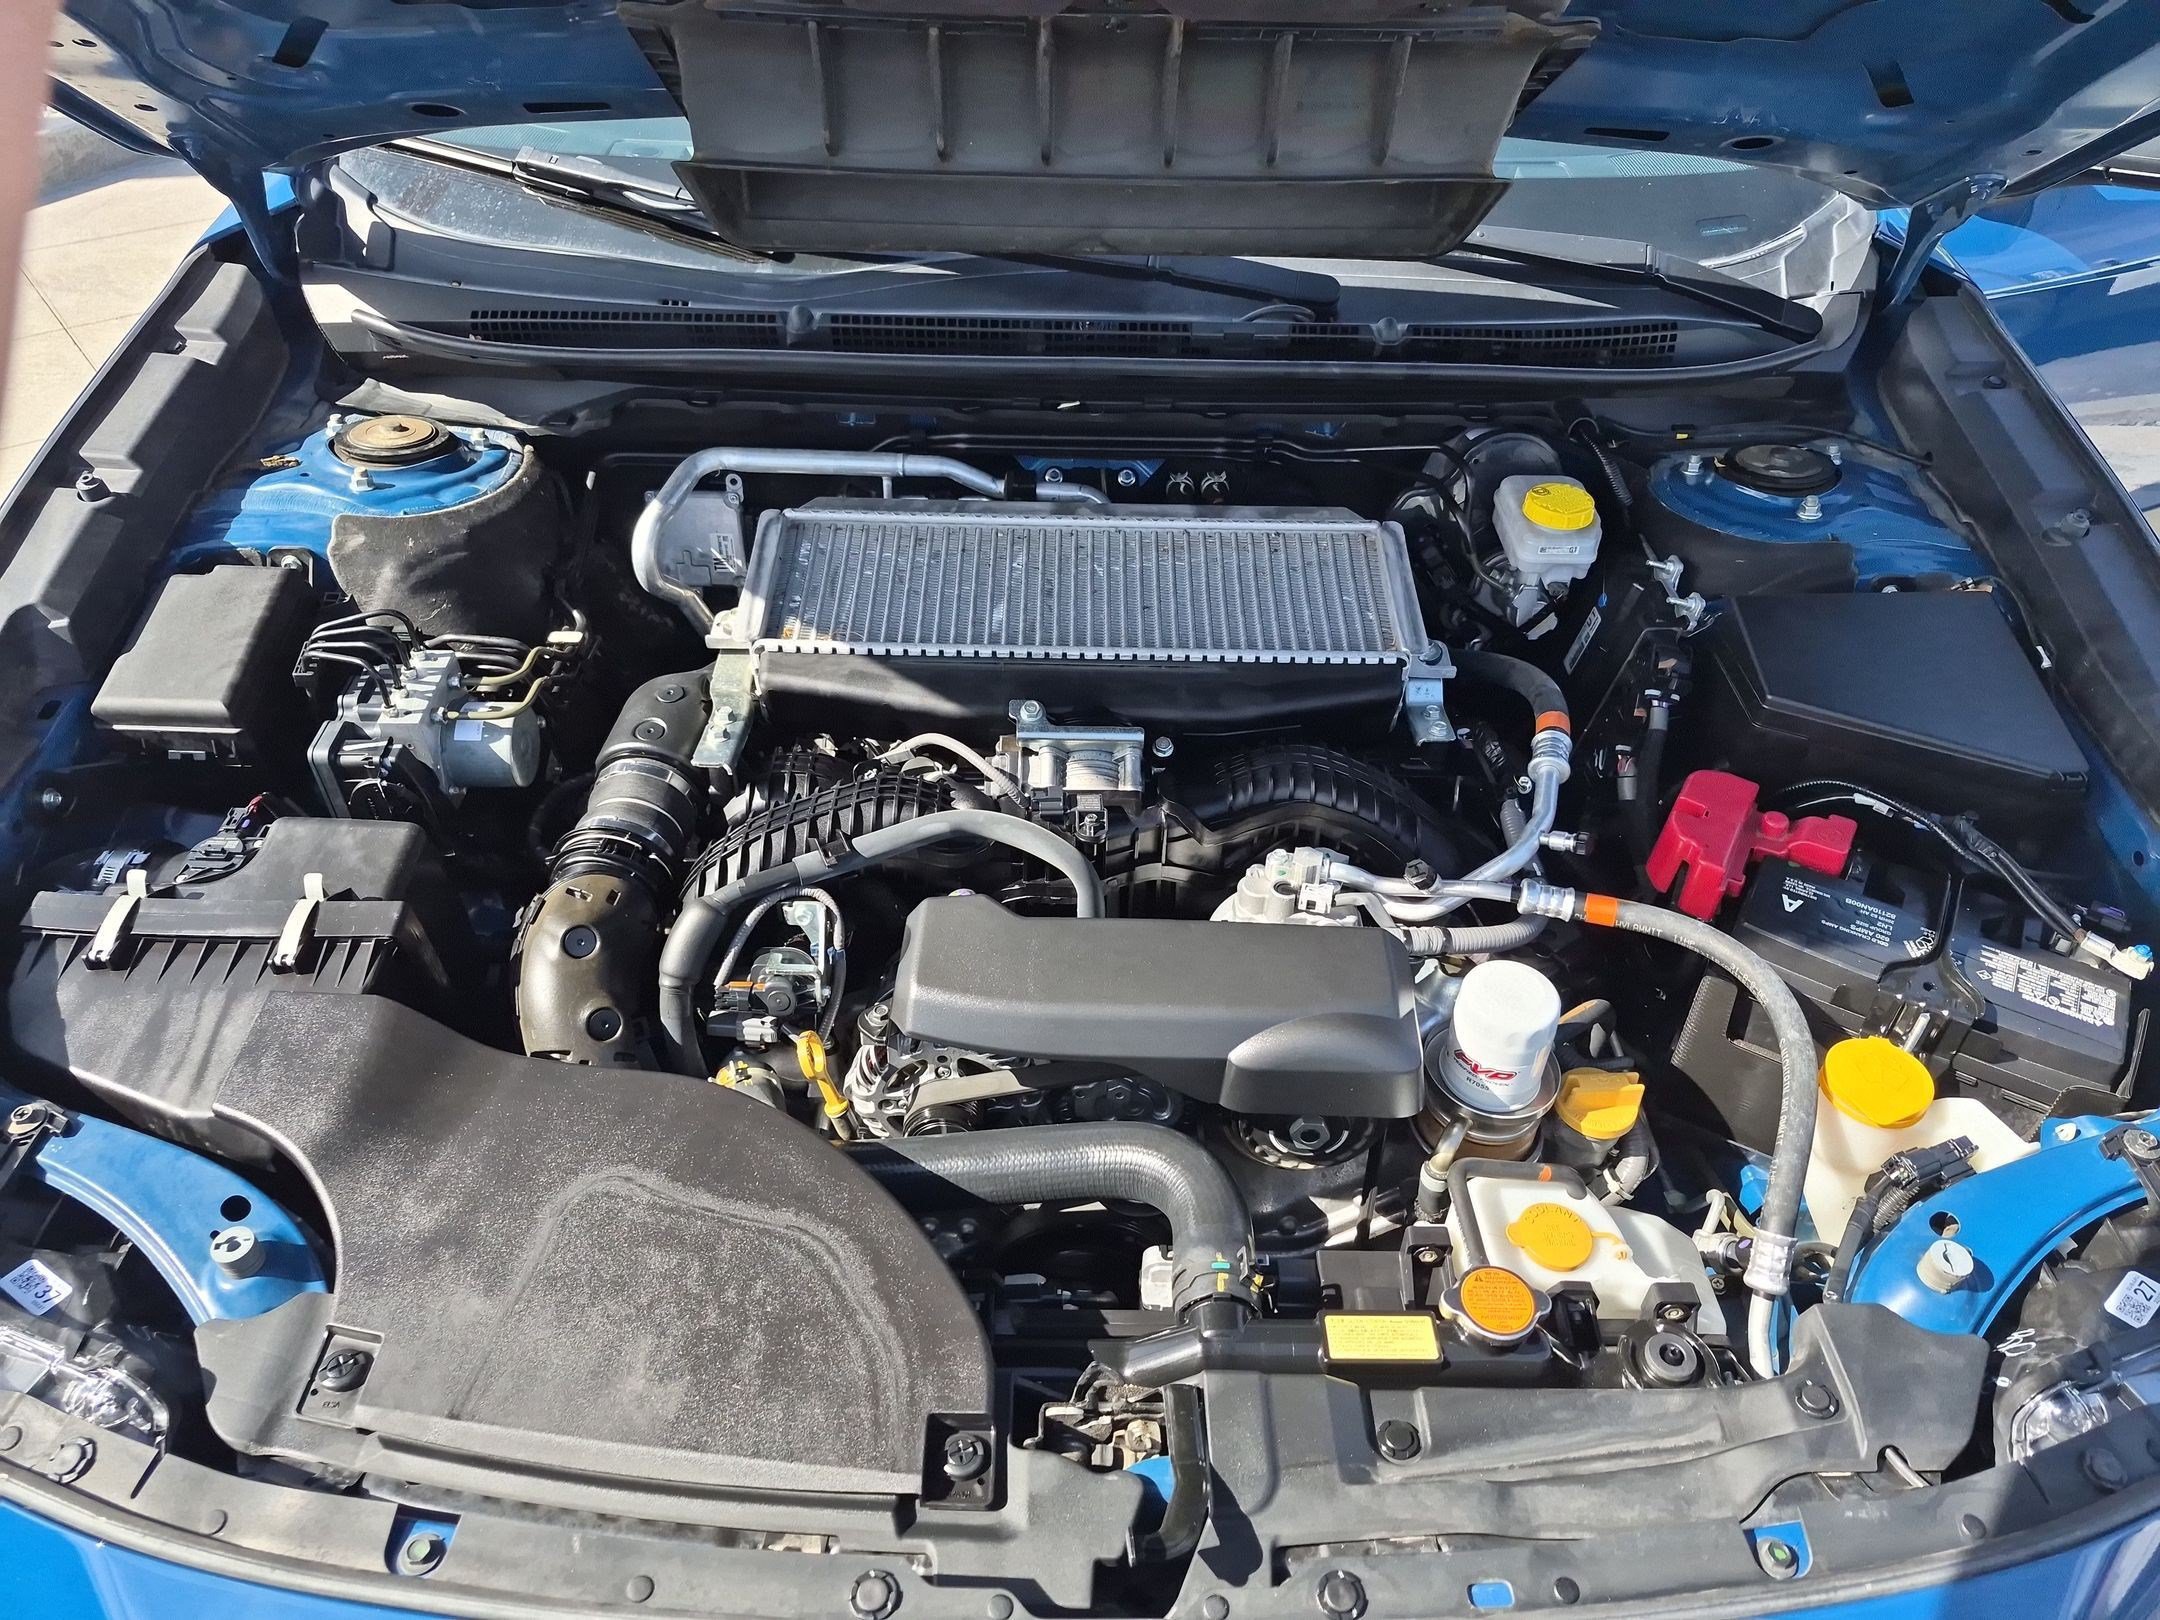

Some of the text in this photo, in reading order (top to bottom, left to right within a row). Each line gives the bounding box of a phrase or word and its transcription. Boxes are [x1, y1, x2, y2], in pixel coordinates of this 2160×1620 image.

[1845, 897, 1897, 920] 82110AN00B
[1850, 924, 1891, 942] 620 AMPS
[1876, 921, 1893, 931] LN2
[1453, 1049, 1518, 1081] FVP
[35, 1284, 62, 1304] 37
[2133, 1279, 2156, 1303] 27
